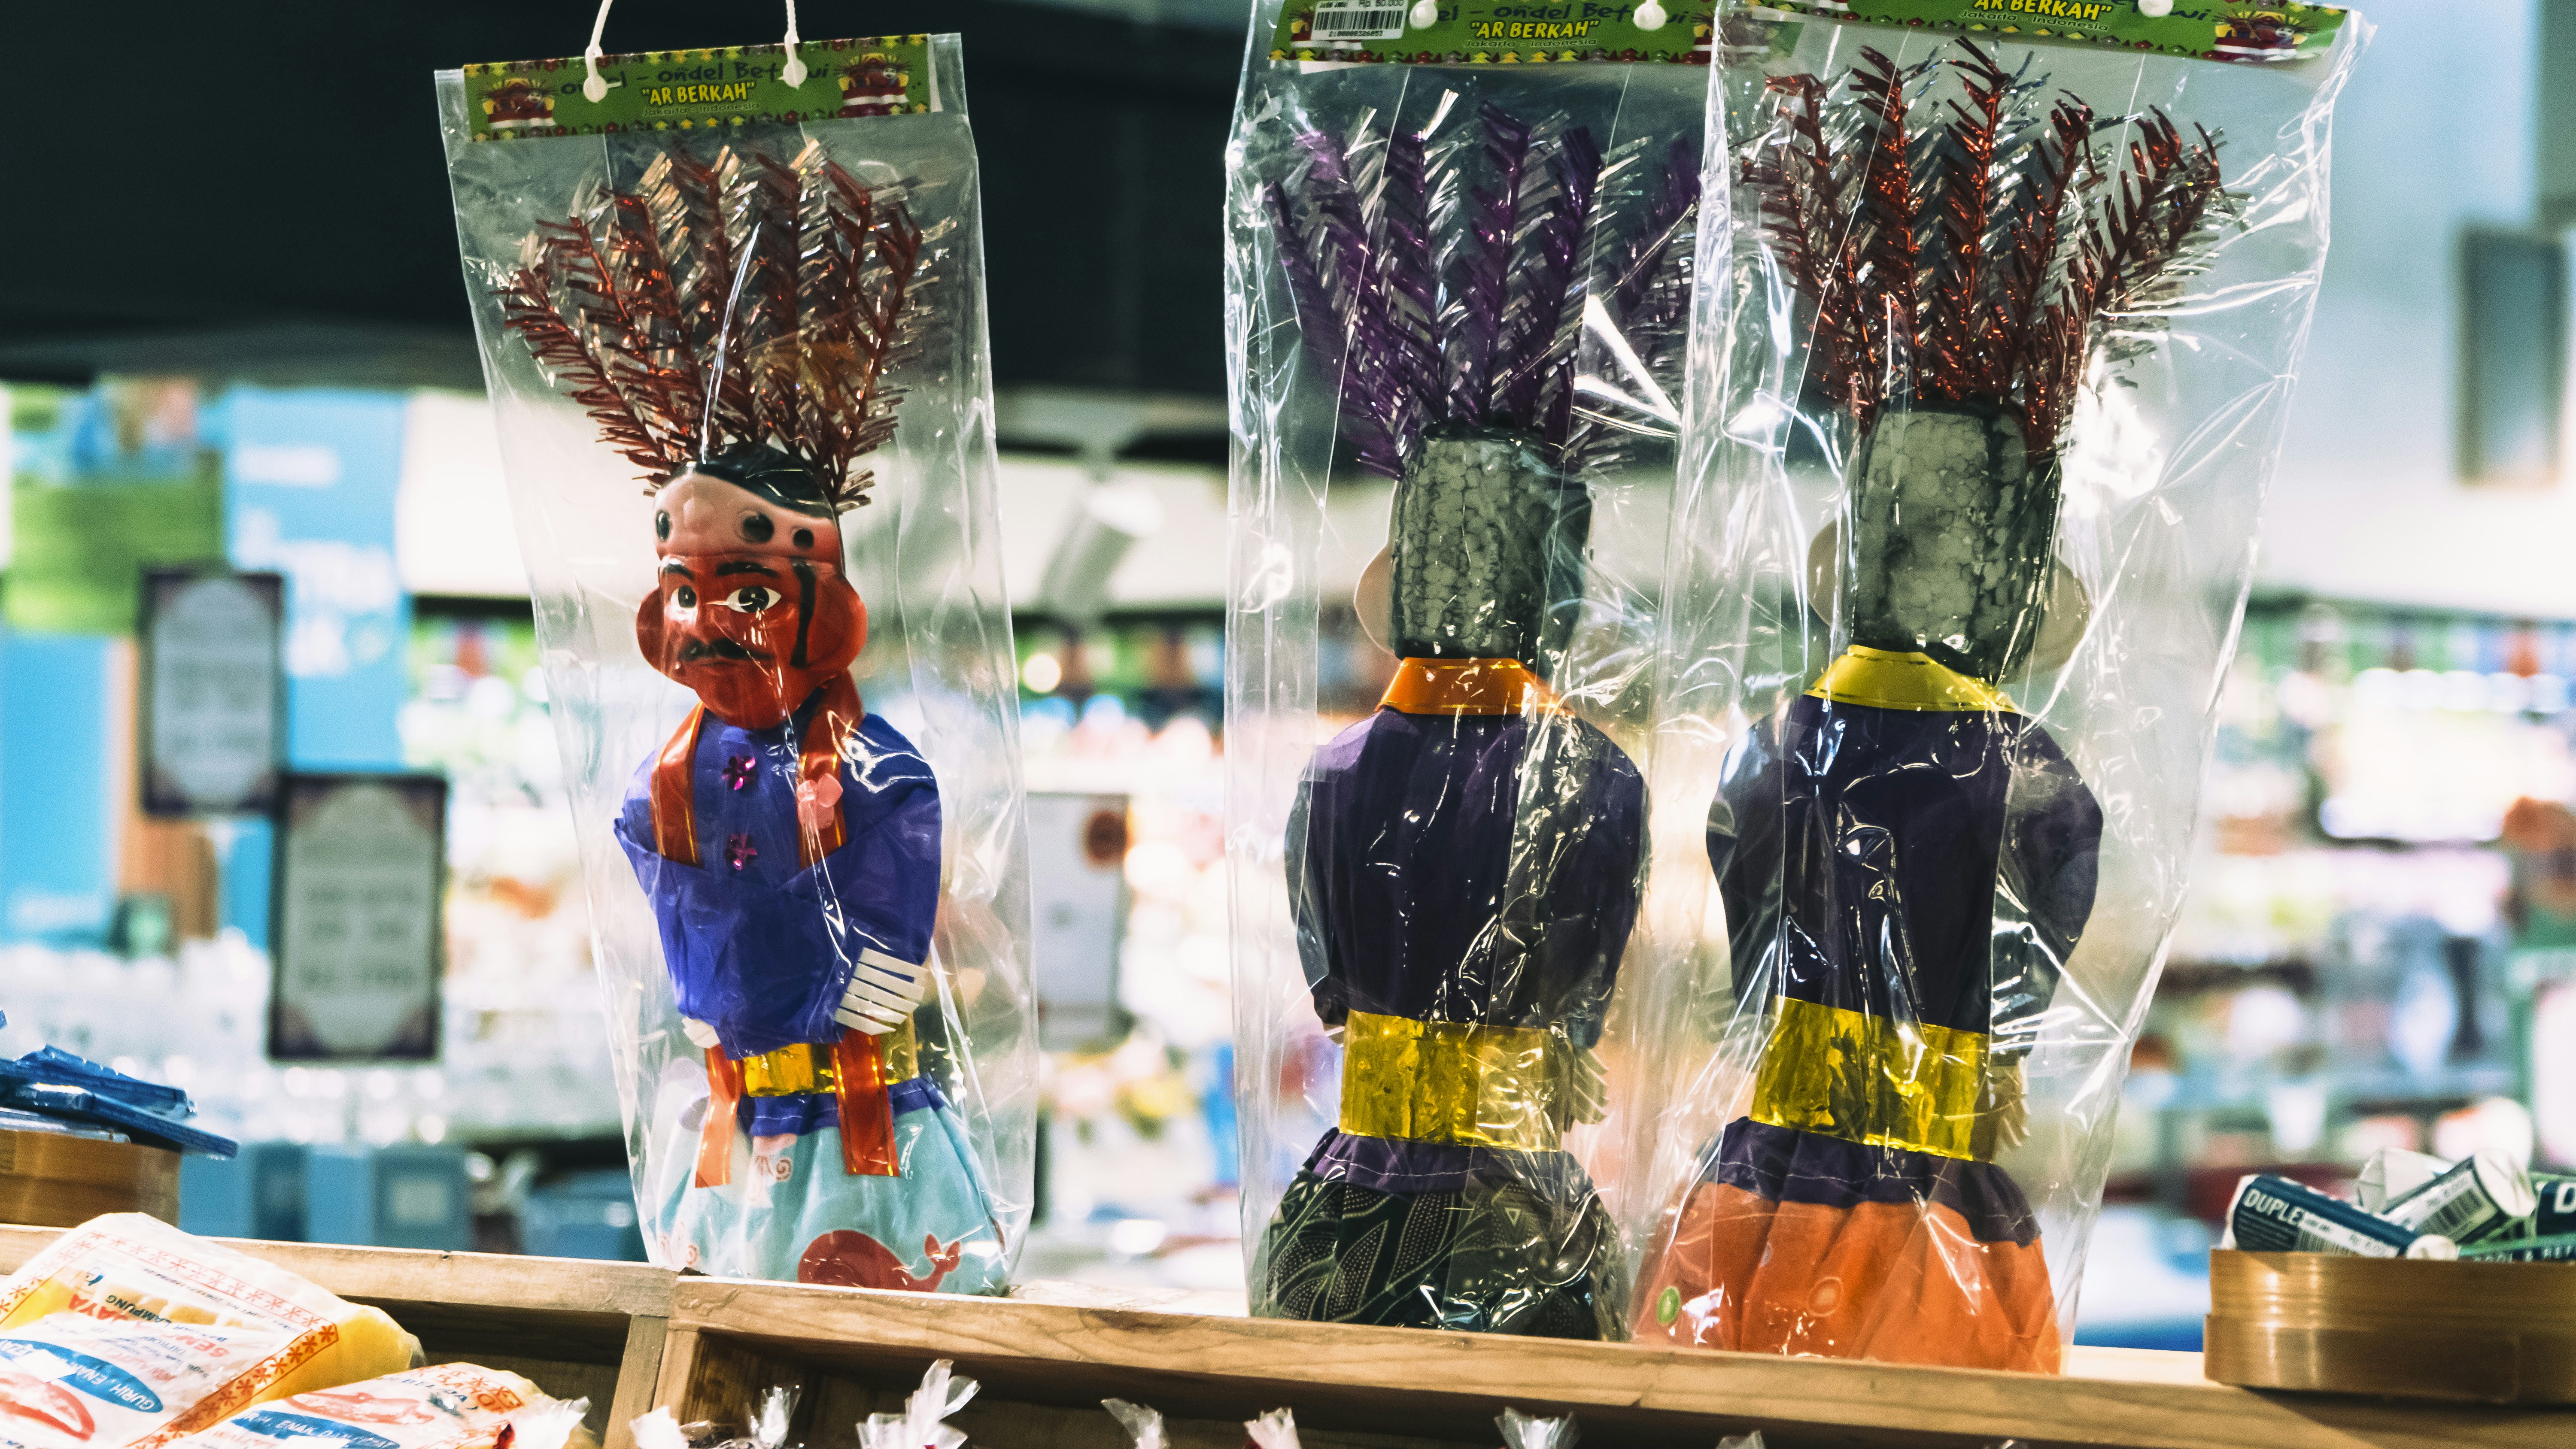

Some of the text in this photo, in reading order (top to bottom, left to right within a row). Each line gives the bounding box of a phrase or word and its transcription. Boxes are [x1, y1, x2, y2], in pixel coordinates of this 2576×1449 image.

[1960, 10, 2017, 21] Jakarta
[2032, 15, 2109, 31] Indonesia
[1530, 39, 1597, 47] Indonesia
[2243, 1188, 2306, 1226] DUPLE
[106, 1294, 173, 1325] LAMPUNG
